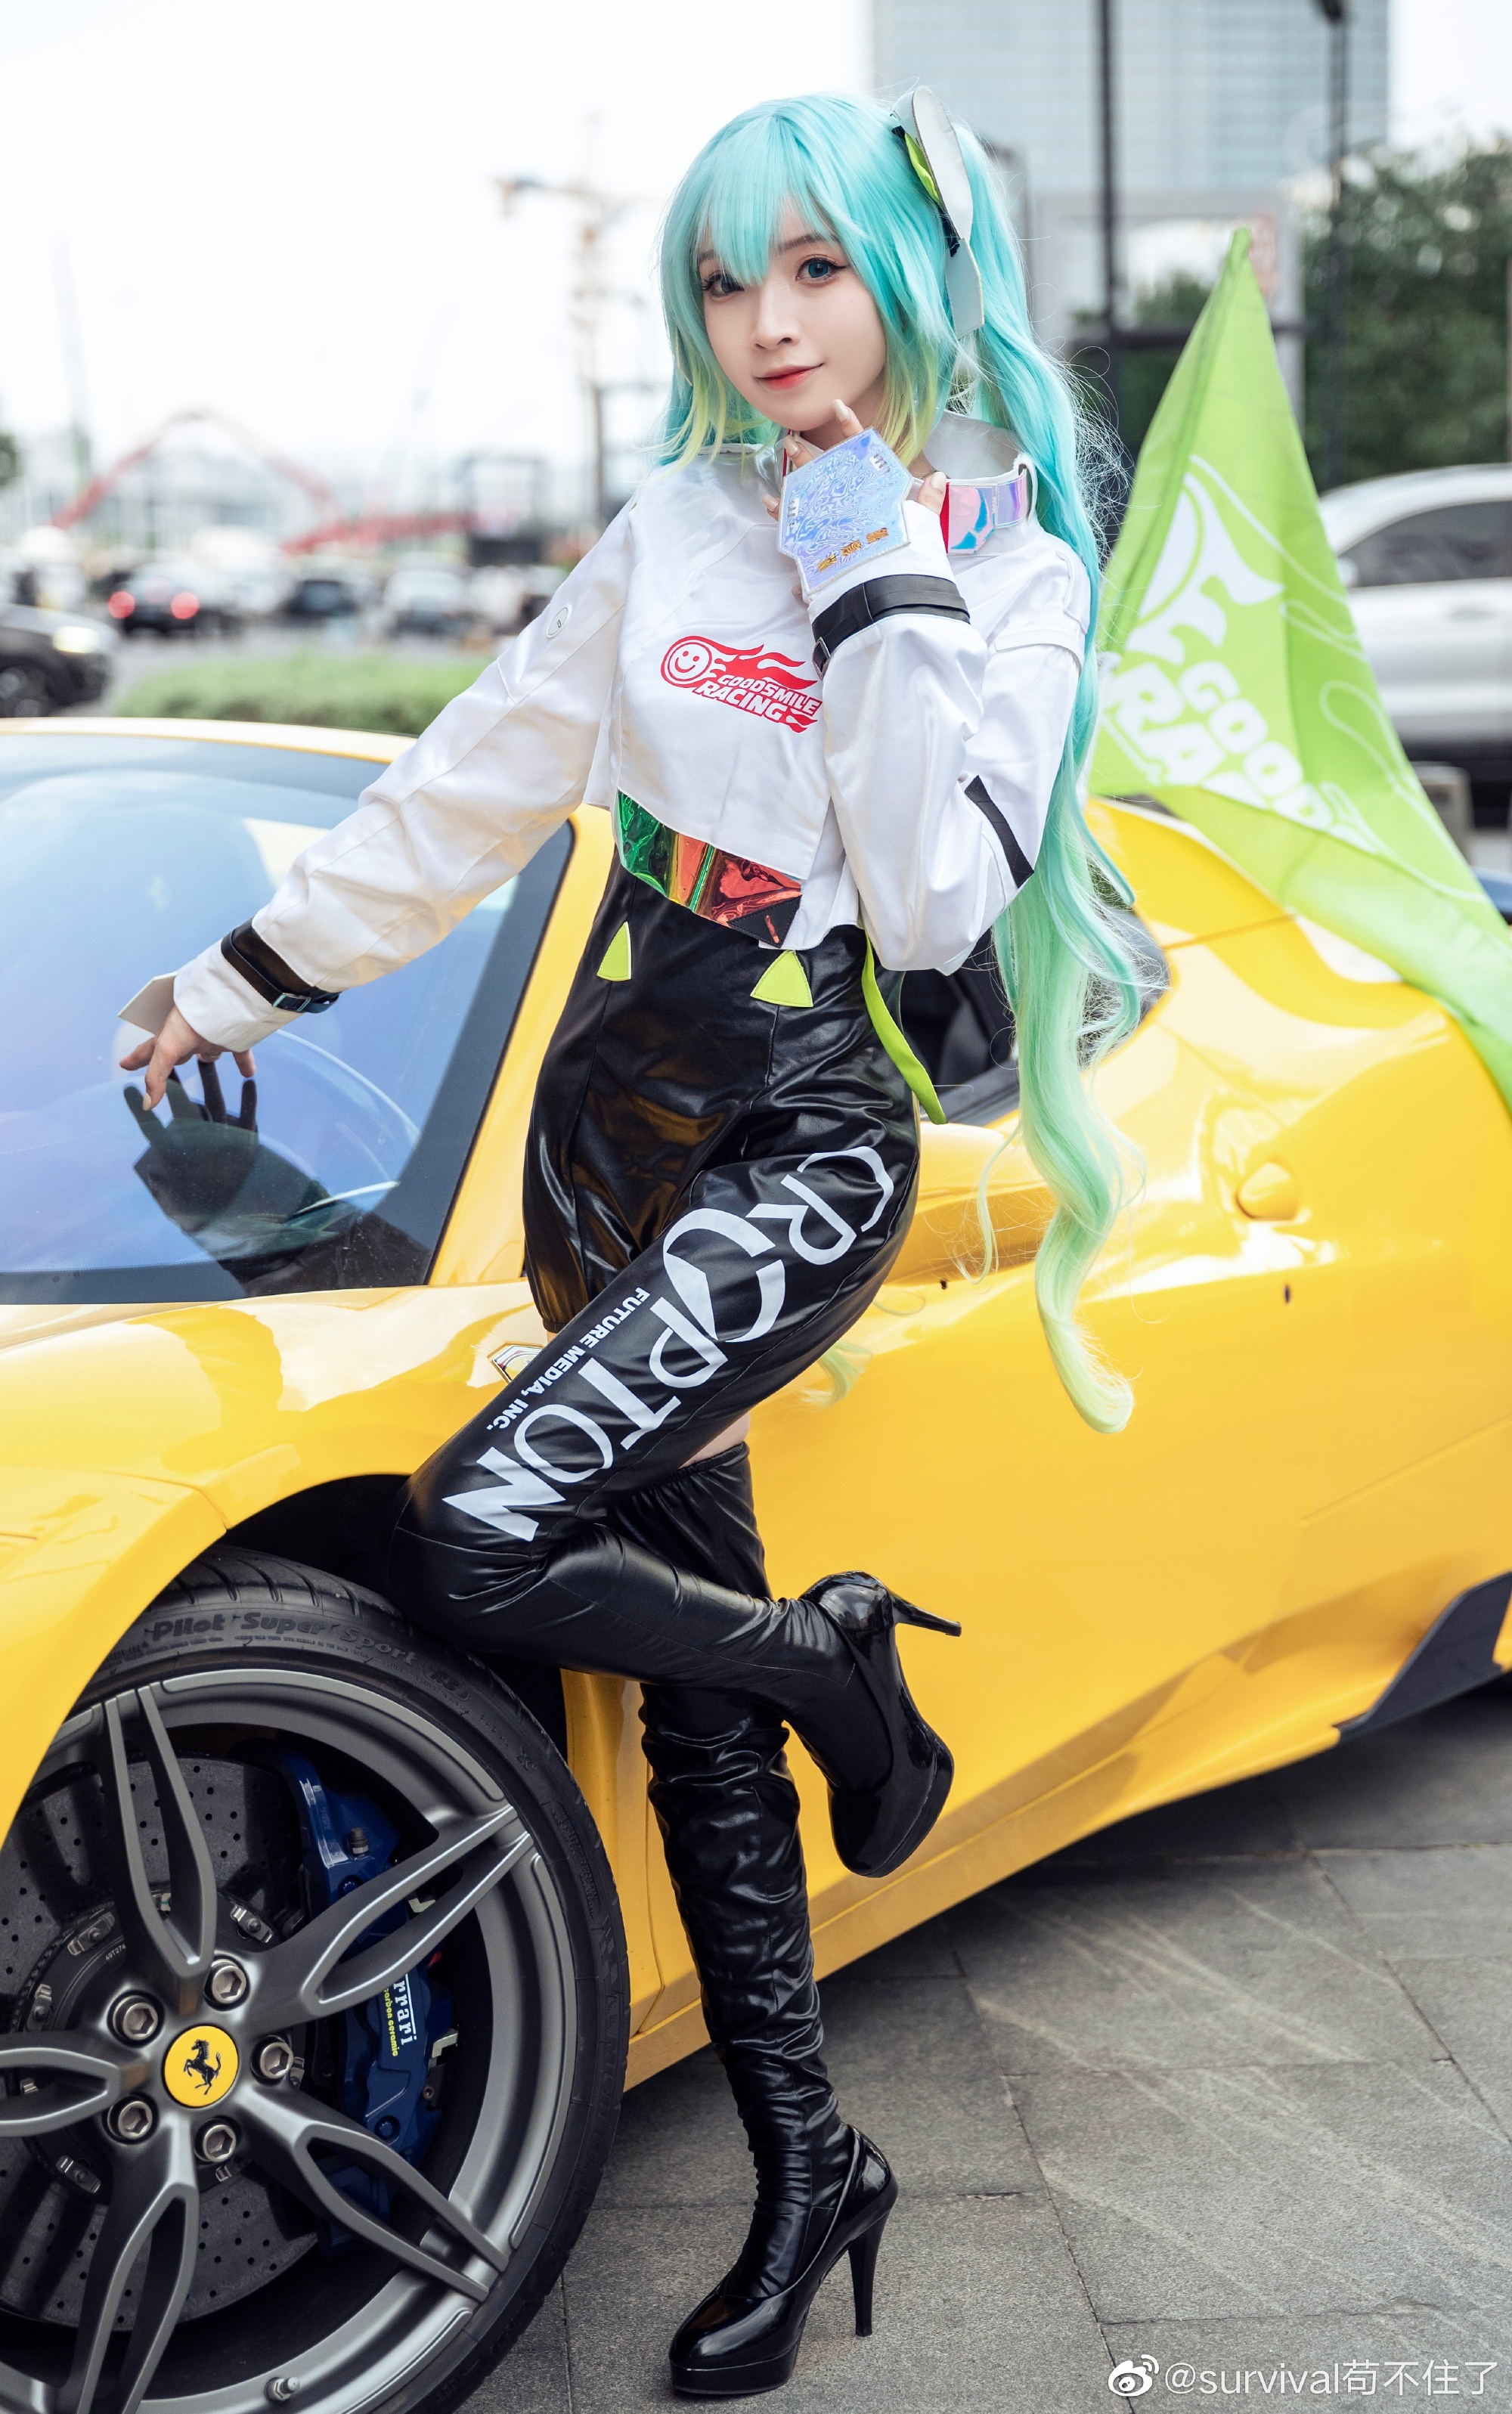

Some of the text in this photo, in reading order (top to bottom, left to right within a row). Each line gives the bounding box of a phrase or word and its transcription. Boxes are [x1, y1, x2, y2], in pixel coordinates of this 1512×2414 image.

[696, 680, 788, 720] RACING
[486, 1288, 651, 1430] FUTURE MEDIA, INC.
[240, 1612, 327, 1635] Super
[339, 1627, 417, 1666] Sport
[393, 1974, 417, 2045] rrari
[388, 2019, 400, 2056] ceramic
